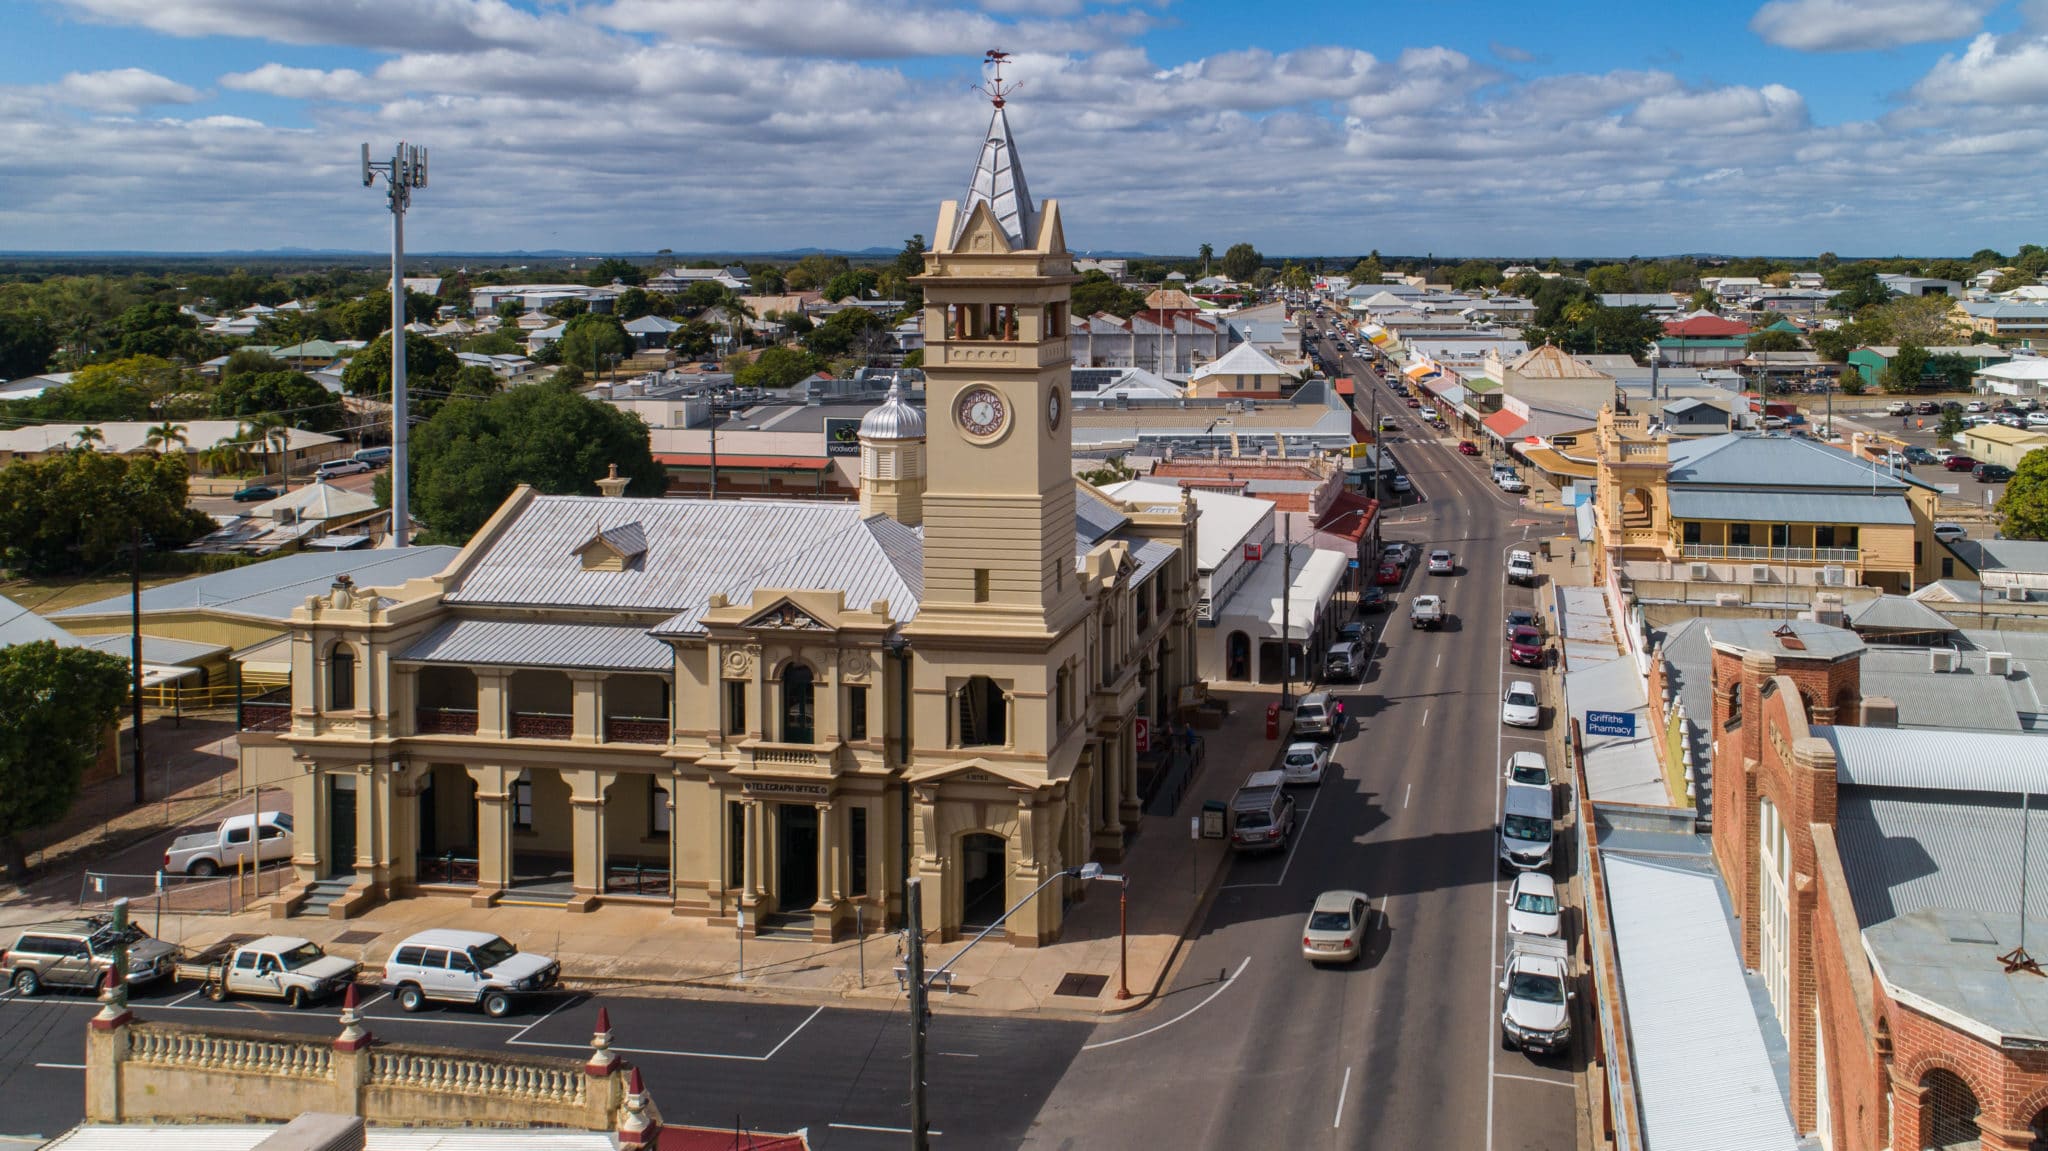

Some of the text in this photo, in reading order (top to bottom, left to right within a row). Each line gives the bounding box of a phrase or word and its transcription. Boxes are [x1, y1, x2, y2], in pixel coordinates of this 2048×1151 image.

[1589, 713, 1624, 724] Griffiths
[1589, 723, 1632, 736] Pharmacy
[752, 783, 820, 794] TELEGRAPH OFFICE
